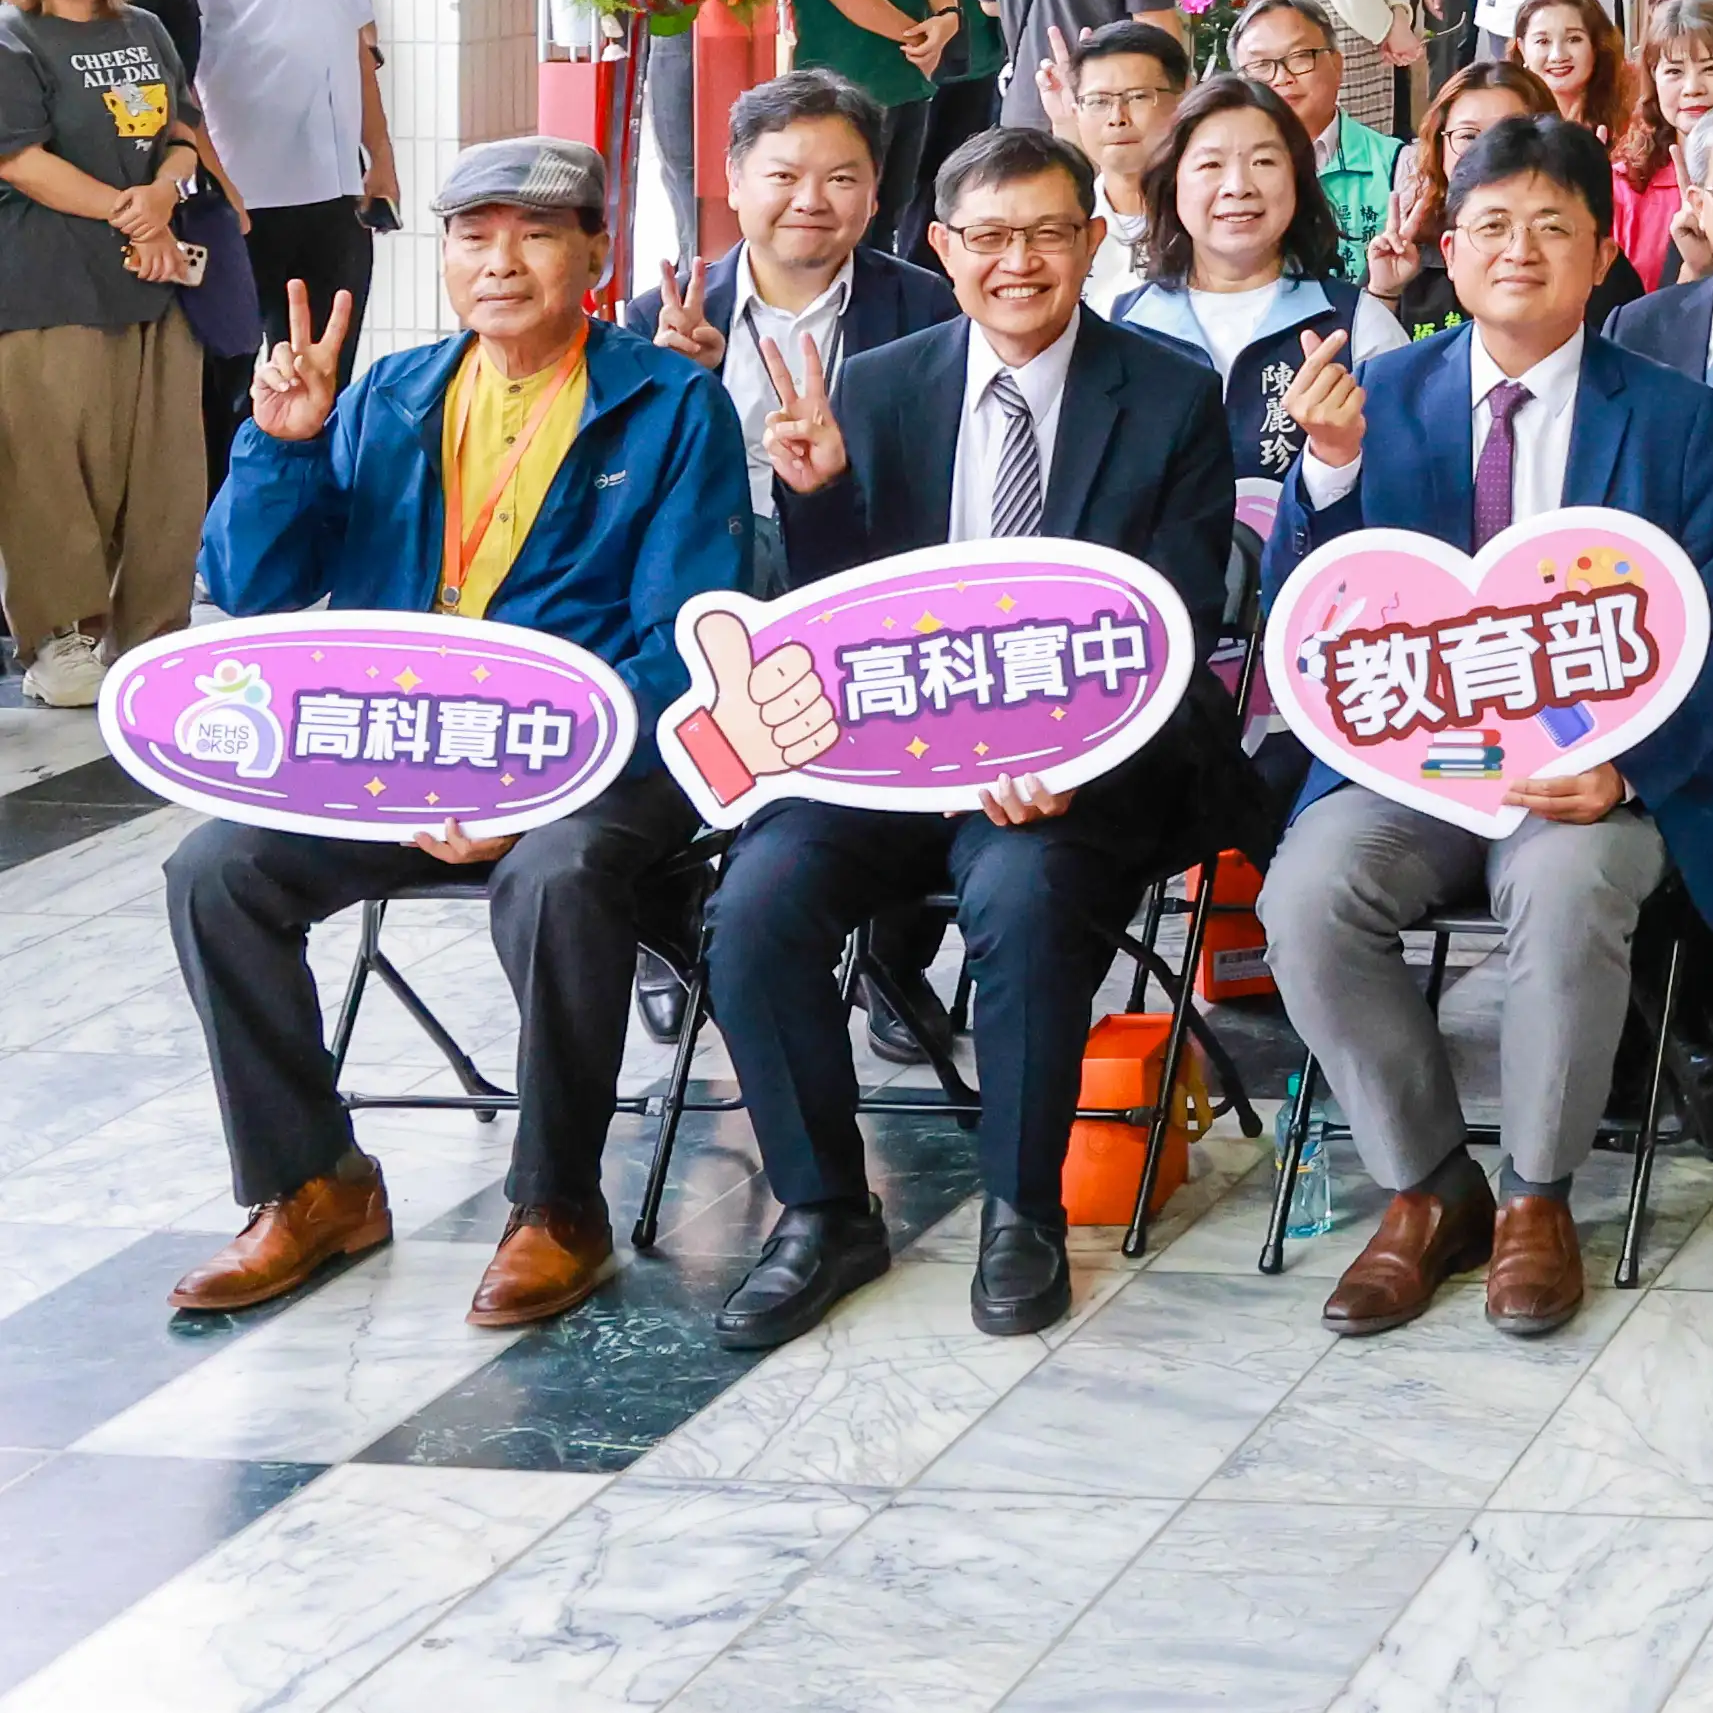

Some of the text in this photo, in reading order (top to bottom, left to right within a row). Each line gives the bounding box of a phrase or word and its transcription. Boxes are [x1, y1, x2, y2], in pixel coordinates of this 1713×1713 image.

[70, 46, 152, 71] CHEESE
[84, 63, 161, 88] ALL DAY
[1259, 362, 1301, 475] 陳麗珍
[841, 617, 1148, 721] 高科實中
[1334, 595, 1651, 737] 教育部
[199, 724, 249, 739] NEHS
[294, 692, 572, 770] 高科實中
